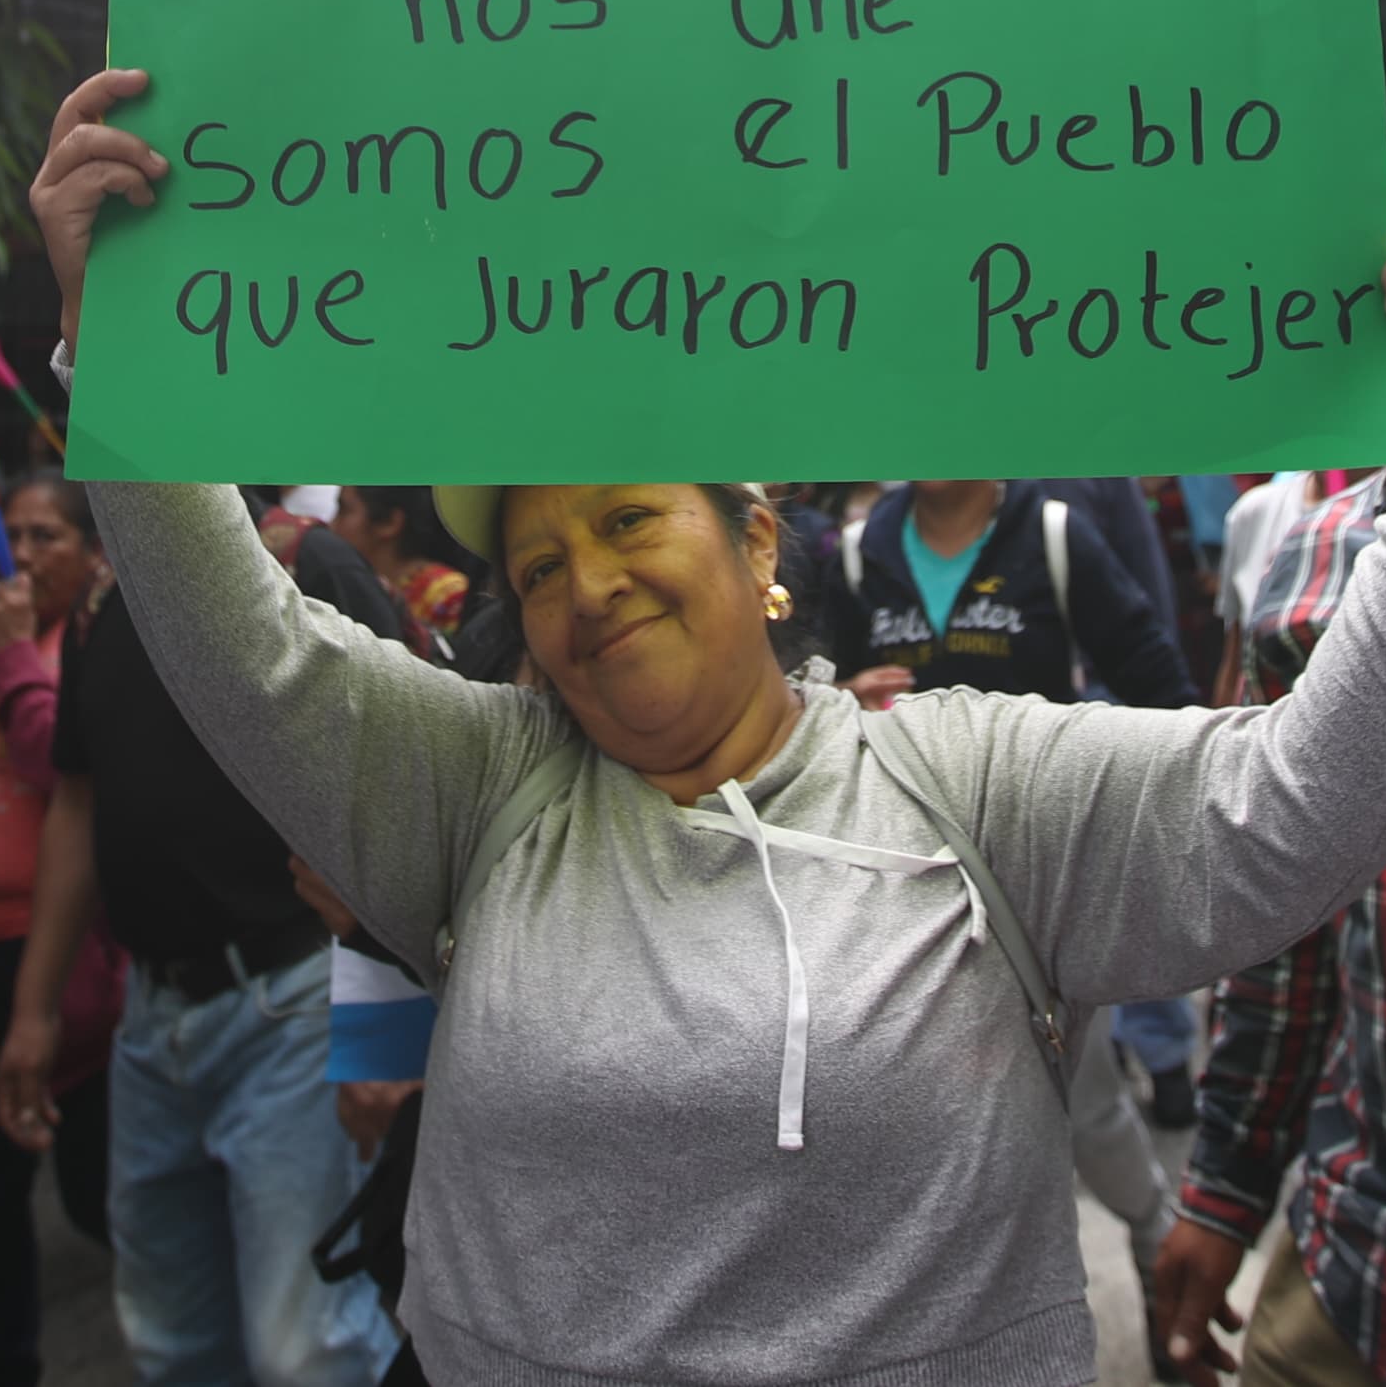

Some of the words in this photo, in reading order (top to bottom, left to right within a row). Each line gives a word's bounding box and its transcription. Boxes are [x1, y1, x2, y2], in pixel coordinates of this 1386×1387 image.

[734, 78, 849, 169] el
[917, 71, 1281, 177] Pueblo
[176, 269, 375, 376] que
[968, 242, 1376, 381] Protejer
